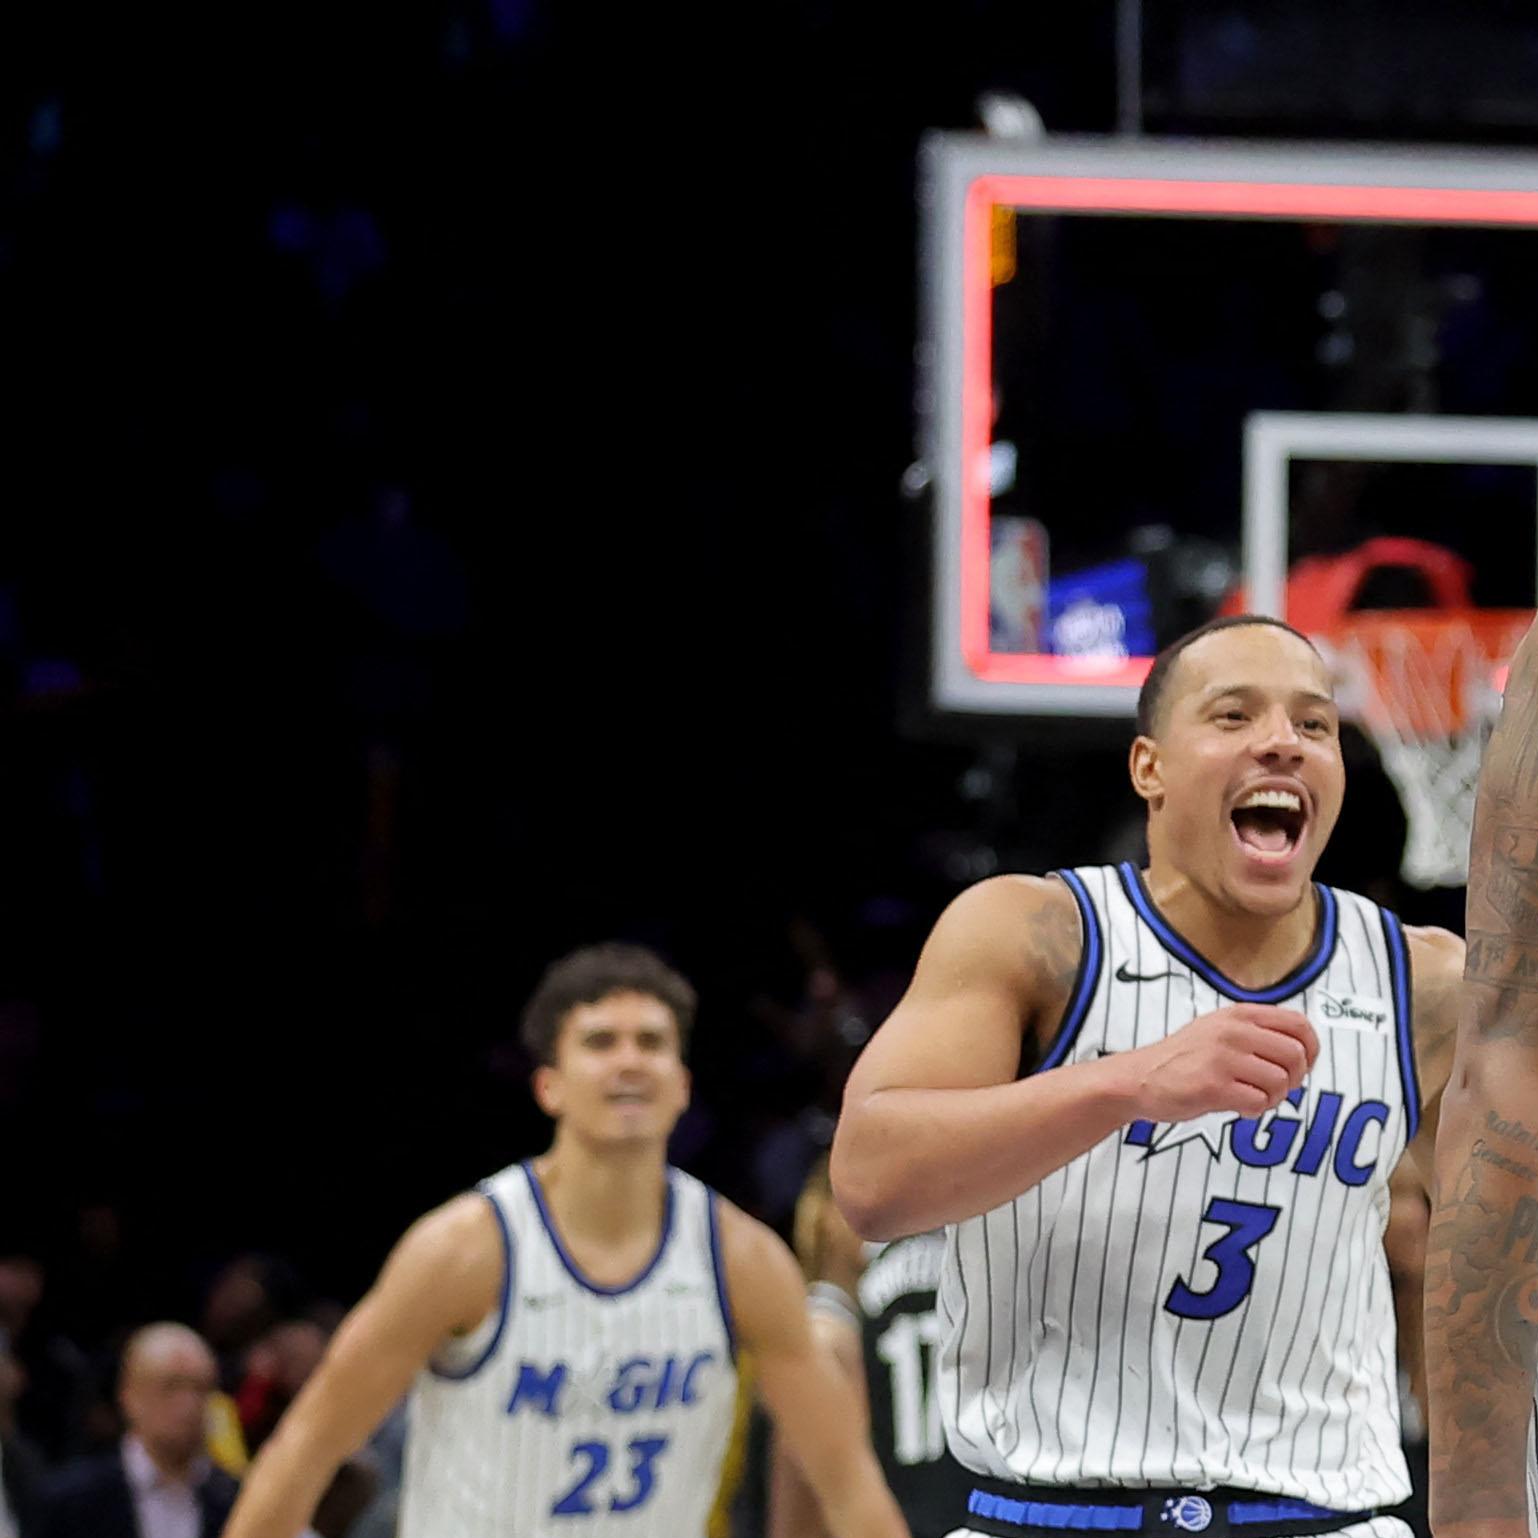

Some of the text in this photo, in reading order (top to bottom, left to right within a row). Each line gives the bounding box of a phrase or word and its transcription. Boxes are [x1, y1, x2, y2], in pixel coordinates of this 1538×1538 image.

[1100, 1054, 1391, 1188] GIC
[1163, 1195, 1283, 1321] 3
[506, 1354, 715, 1419] MGIC
[550, 1436, 669, 1516] 23
